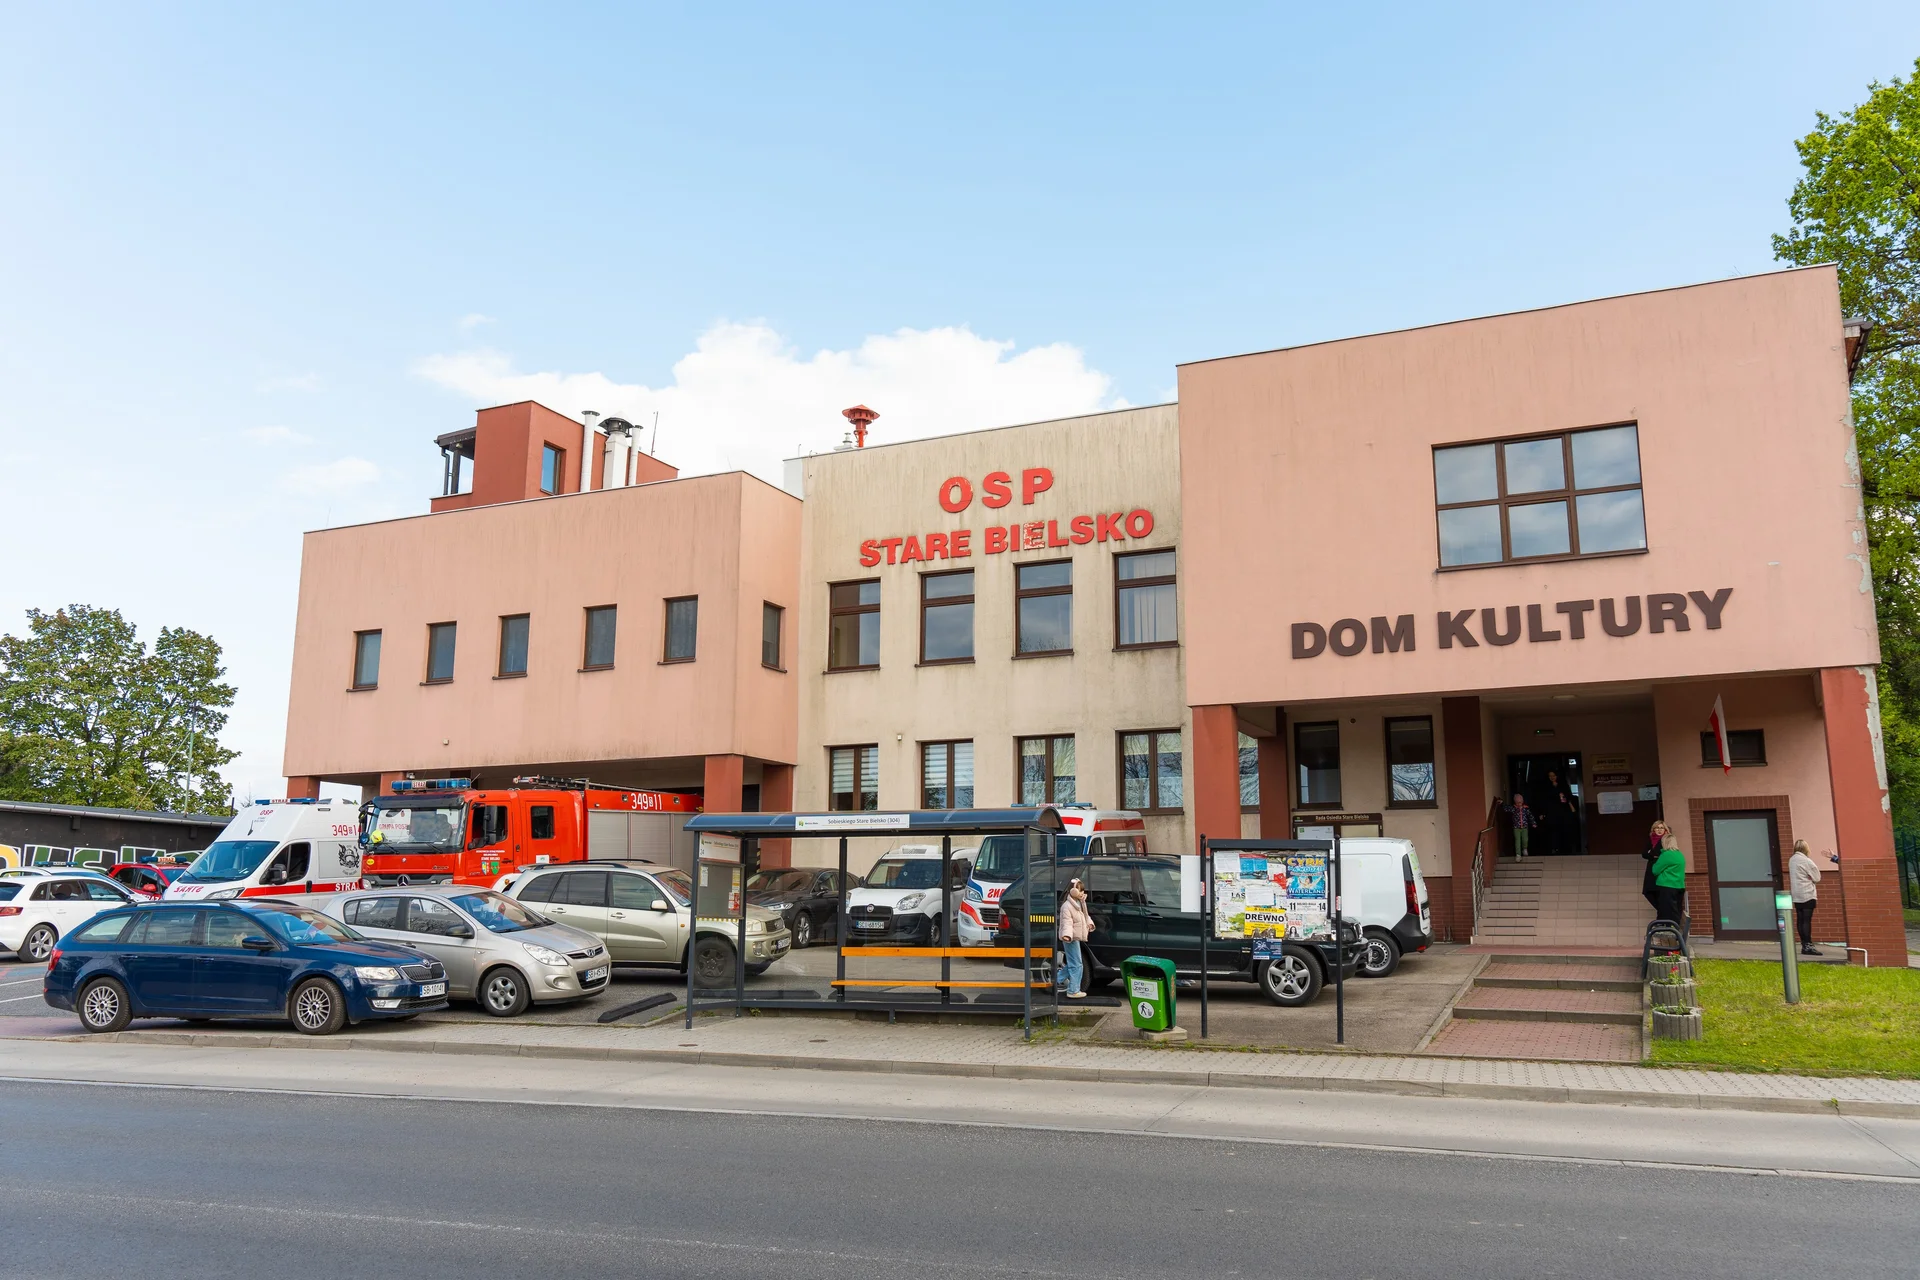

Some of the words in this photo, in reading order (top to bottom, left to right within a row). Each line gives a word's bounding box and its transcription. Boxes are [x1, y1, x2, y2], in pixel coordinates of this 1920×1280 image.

[938, 467, 1054, 513] OSP
[859, 529, 972, 567] STARE
[984, 509, 1154, 555] BIELSKO
[1291, 613, 1416, 660] DOM
[1436, 587, 1734, 650] KULTURY
[1287, 857, 1325, 866] CYRK
[335, 882, 359, 892] STRA
[1245, 913, 1285, 922] DREWNO
